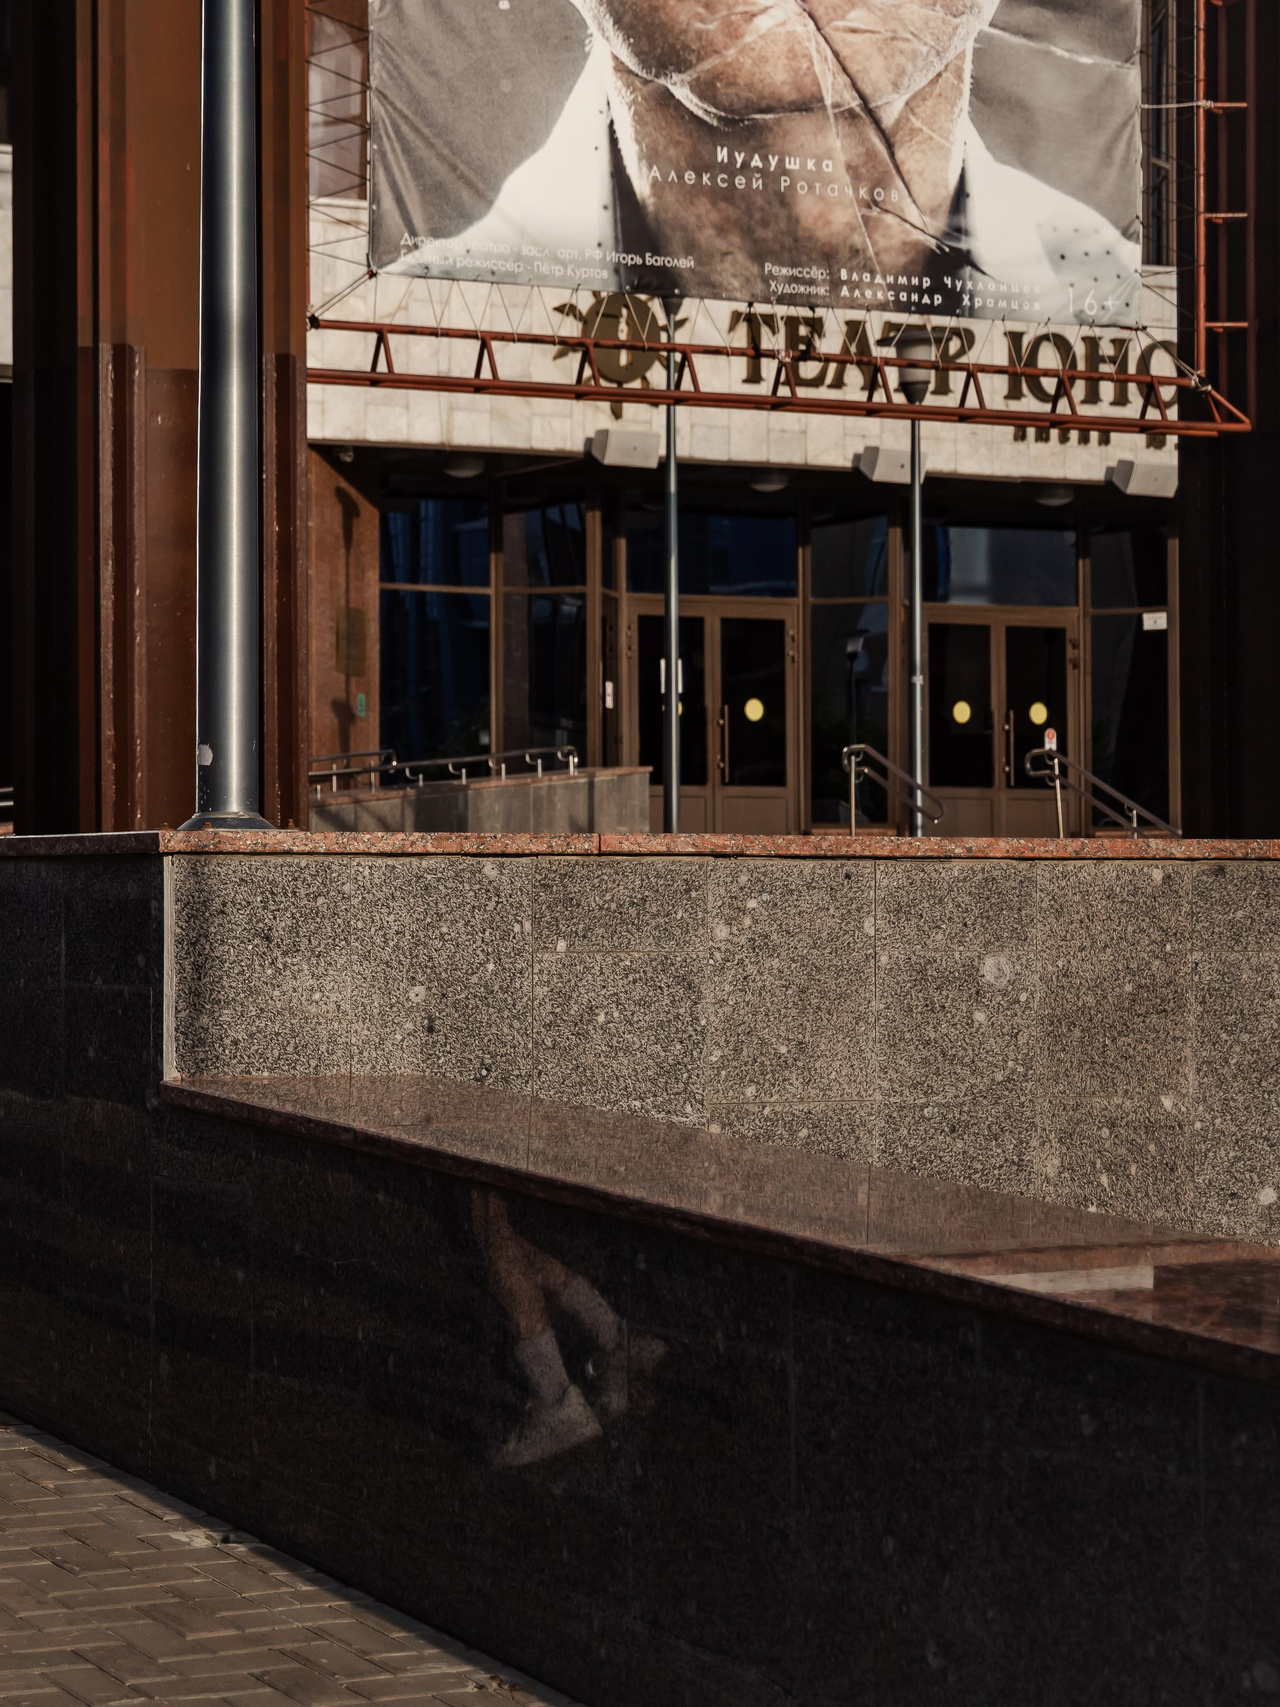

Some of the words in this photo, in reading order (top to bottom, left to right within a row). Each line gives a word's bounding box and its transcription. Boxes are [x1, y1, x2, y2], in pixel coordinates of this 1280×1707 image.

[716, 145, 834, 173] Иудушка
[649, 164, 763, 191] Алексей
[780, 175, 899, 202] Ротачков
[400, 232, 464, 253] Директор
[557, 247, 583, 263] арт.
[584, 246, 604, 262] РФ
[605, 248, 644, 267] Игорь
[645, 250, 696, 269] Баголей
[456, 255, 523, 275] режиссёр
[533, 262, 566, 279] Пётр
[567, 265, 609, 282] Куртов
[764, 261, 830, 281] Режиссёр:
[840, 268, 931, 289] Владимир
[768, 279, 830, 297] Художник:
[840, 285, 943, 305] Александр
[961, 295, 1041, 312] Храмцов
